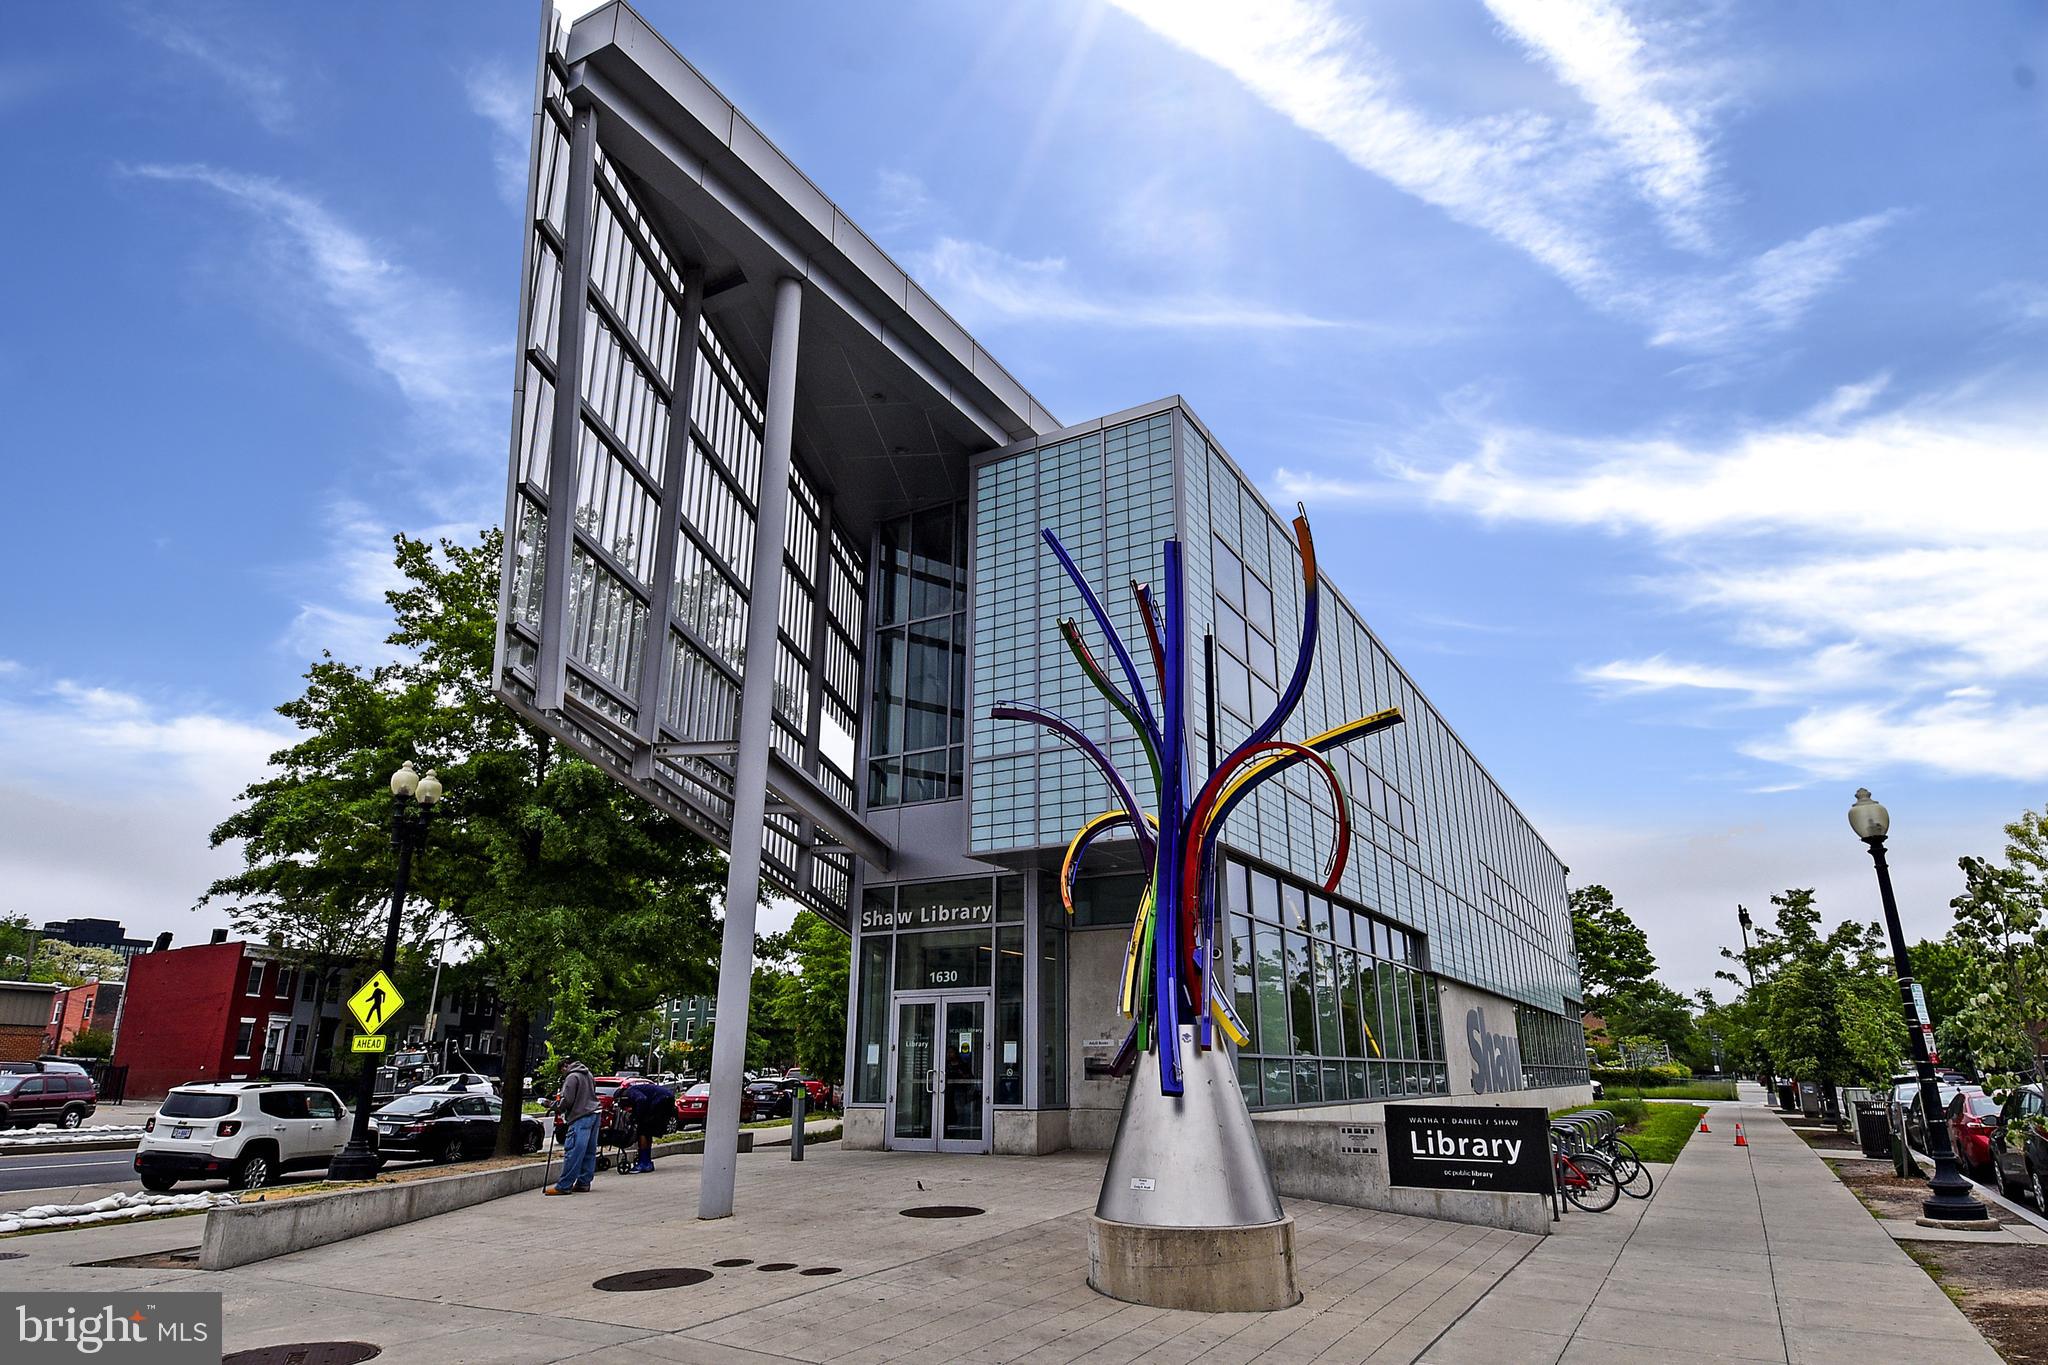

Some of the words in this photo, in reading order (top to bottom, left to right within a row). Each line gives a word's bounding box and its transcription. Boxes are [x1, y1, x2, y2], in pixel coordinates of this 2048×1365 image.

[862, 910, 912, 927] Shaw
[920, 904, 992, 922] Library
[929, 971, 958, 984] 1630
[356, 1040, 382, 1048] AHEAD
[905, 1040, 929, 1049] Library
[1466, 1006, 1523, 1095] Shaw
[1409, 1117, 1440, 1125] WATHA
[1451, 1118, 1483, 1126] DANIEL
[1493, 1119, 1520, 1127] SHAW
[1411, 1129, 1522, 1165] Library
[1452, 1169, 1471, 1177] public
[1471, 1170, 1494, 1179] library
